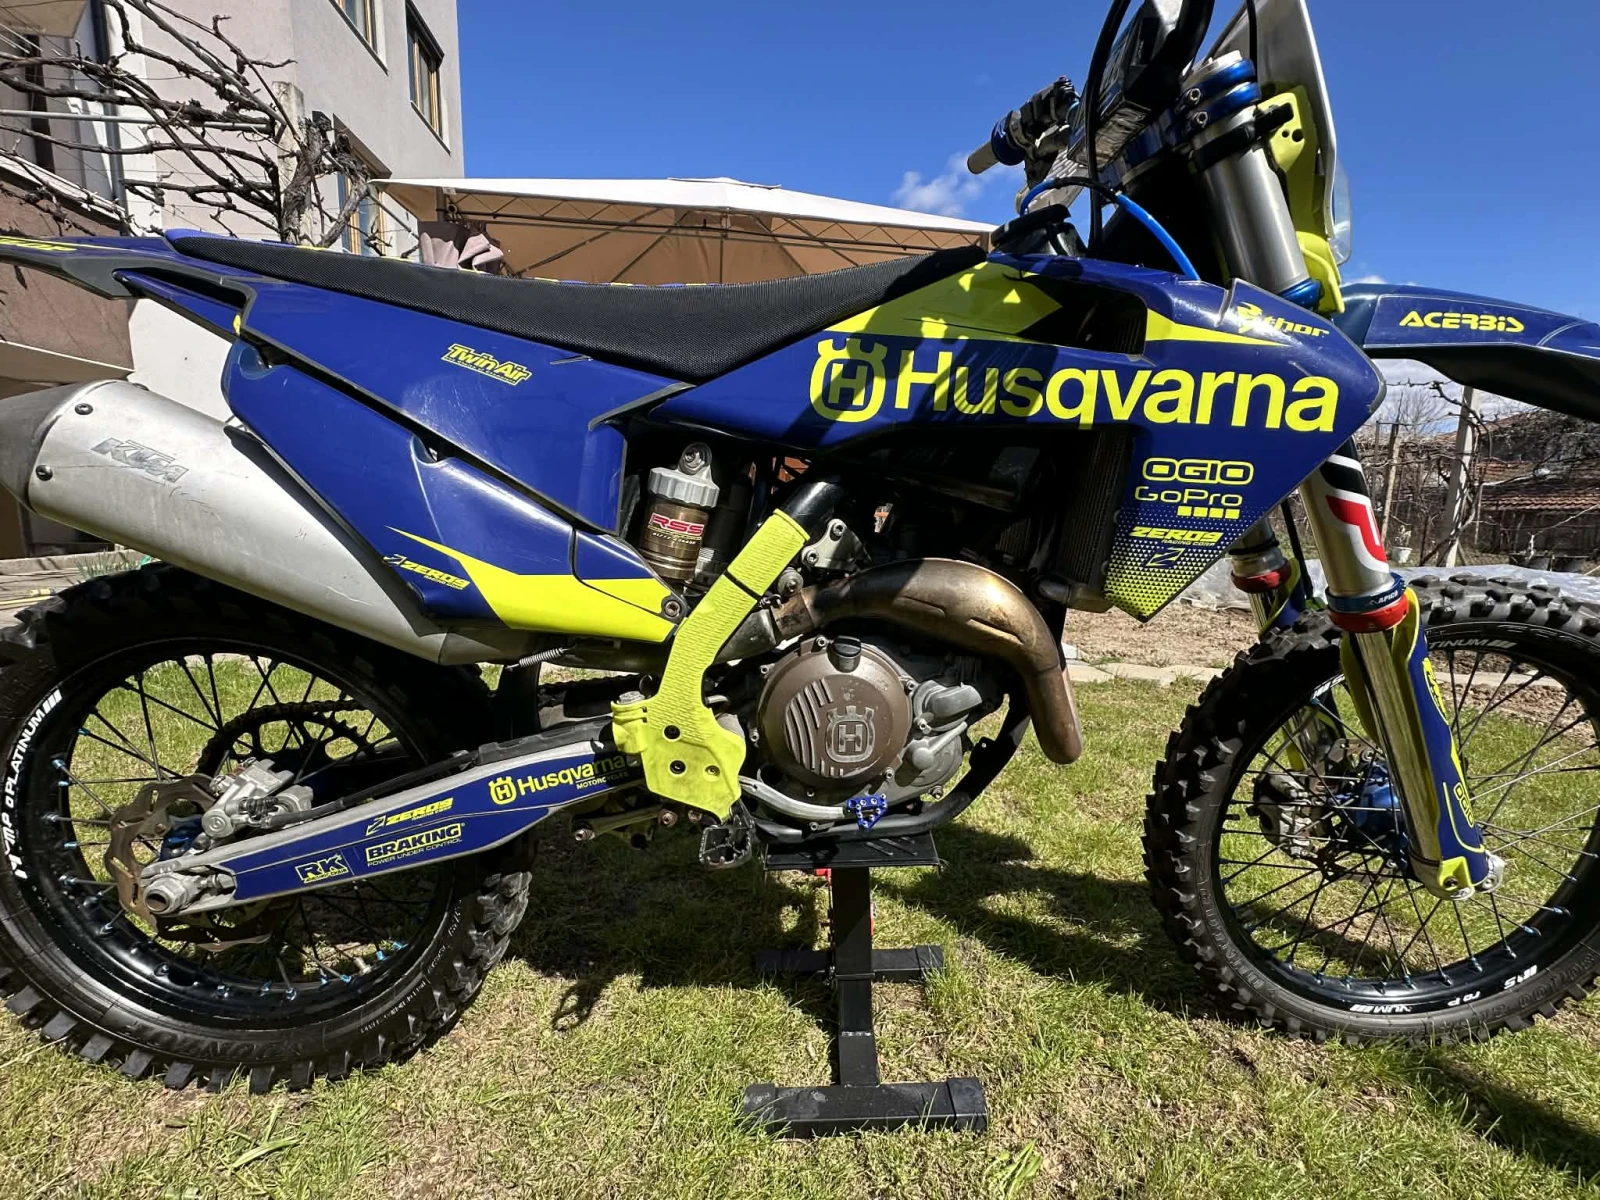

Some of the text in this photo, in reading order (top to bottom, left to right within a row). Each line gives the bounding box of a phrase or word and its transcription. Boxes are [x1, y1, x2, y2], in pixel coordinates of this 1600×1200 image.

[449, 346, 498, 371] Twin
[494, 363, 528, 381] Air
[895, 350, 1340, 432] Husqvarna
[1142, 457, 1254, 485] OGIO
[1134, 486, 1243, 507] GoPro
[650, 513, 704, 536] RSS
[1429, 638, 1487, 649] TINUM
[5, 708, 46, 796] PLATINUM
[517, 755, 625, 795] Husqvarna
[576, 771, 629, 790] MOTORCYCLES
[367, 824, 461, 862] BRAKING
[367, 838, 463, 867] POWER UNDER CONTROL
[295, 854, 348, 881] RK
